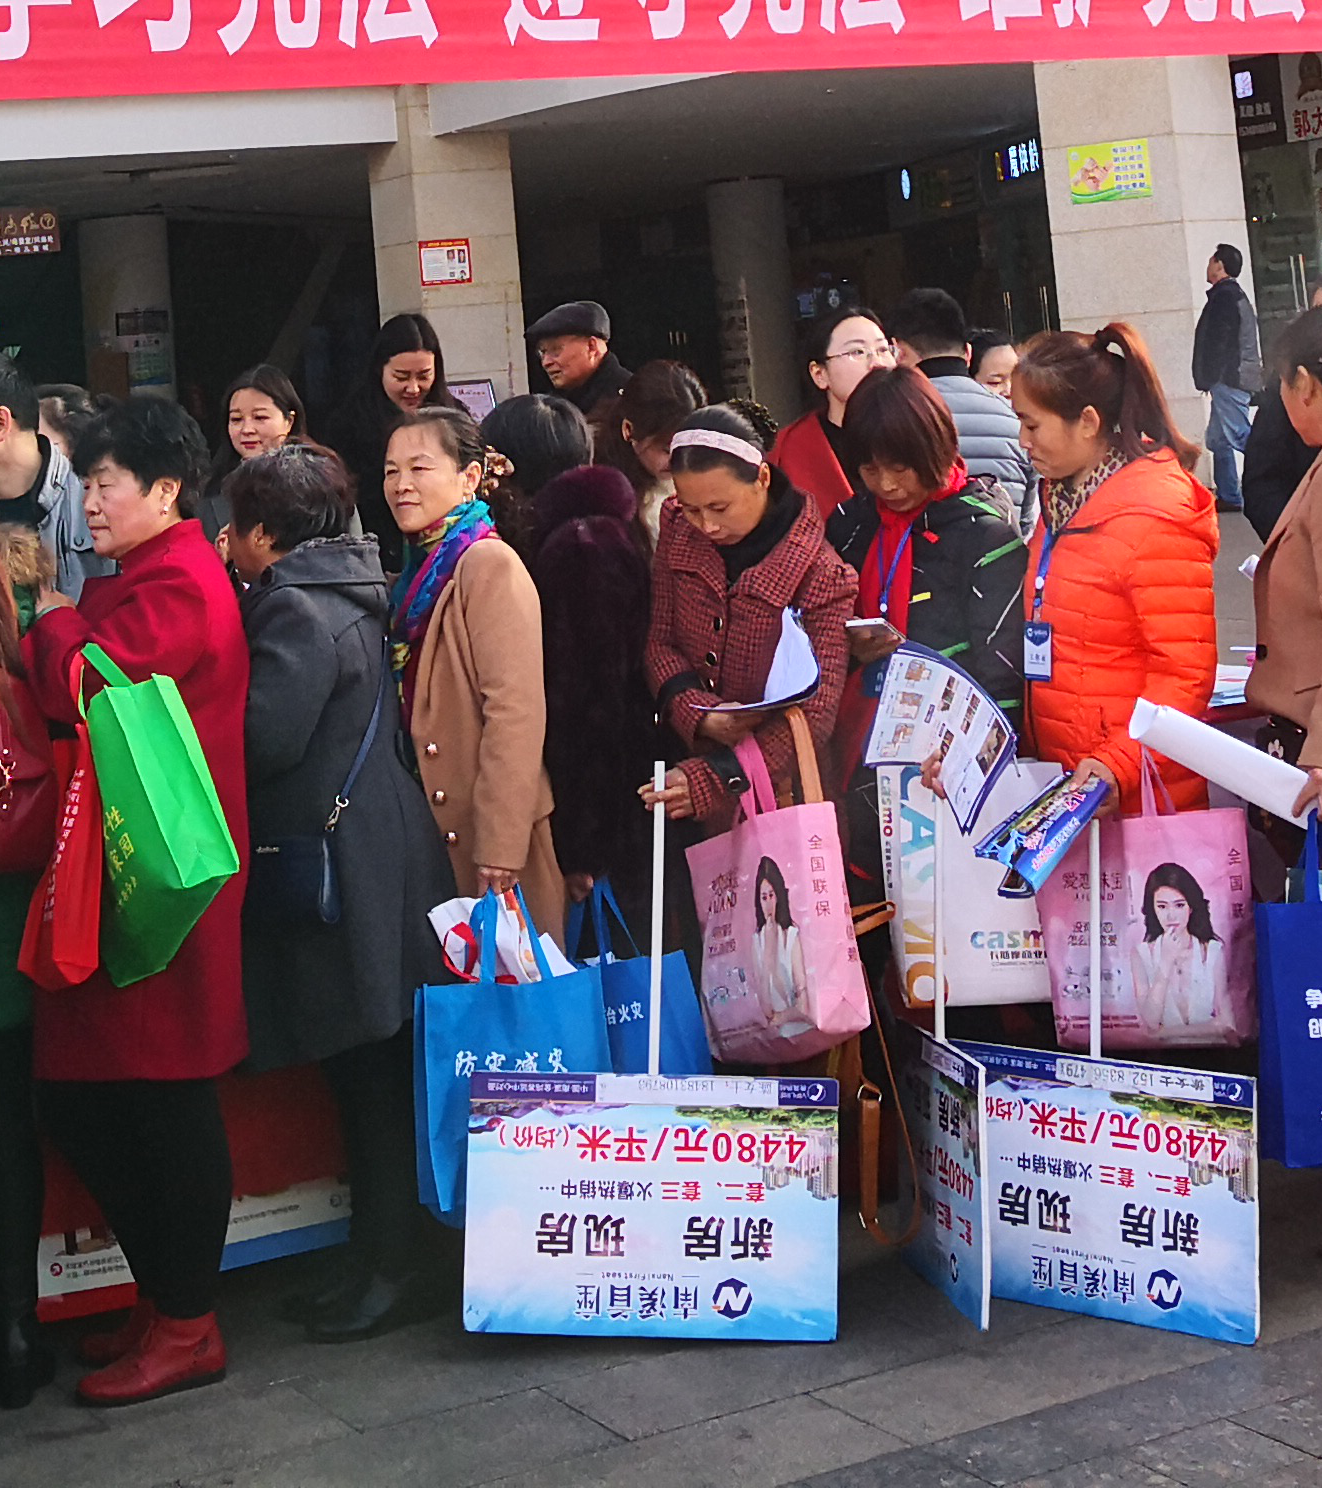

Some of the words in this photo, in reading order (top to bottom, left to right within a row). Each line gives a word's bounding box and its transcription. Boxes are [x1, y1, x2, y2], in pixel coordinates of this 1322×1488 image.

[807, 834, 832, 918] 全国联保
[998, 1181, 1072, 1235] 现房
[1120, 1202, 1200, 1258] 新房
[535, 1212, 627, 1258] 现房
[682, 1215, 774, 1262] 新房
[573, 1283, 699, 1320] 南溪首座
[1032, 1254, 1136, 1304] 南溪首座
